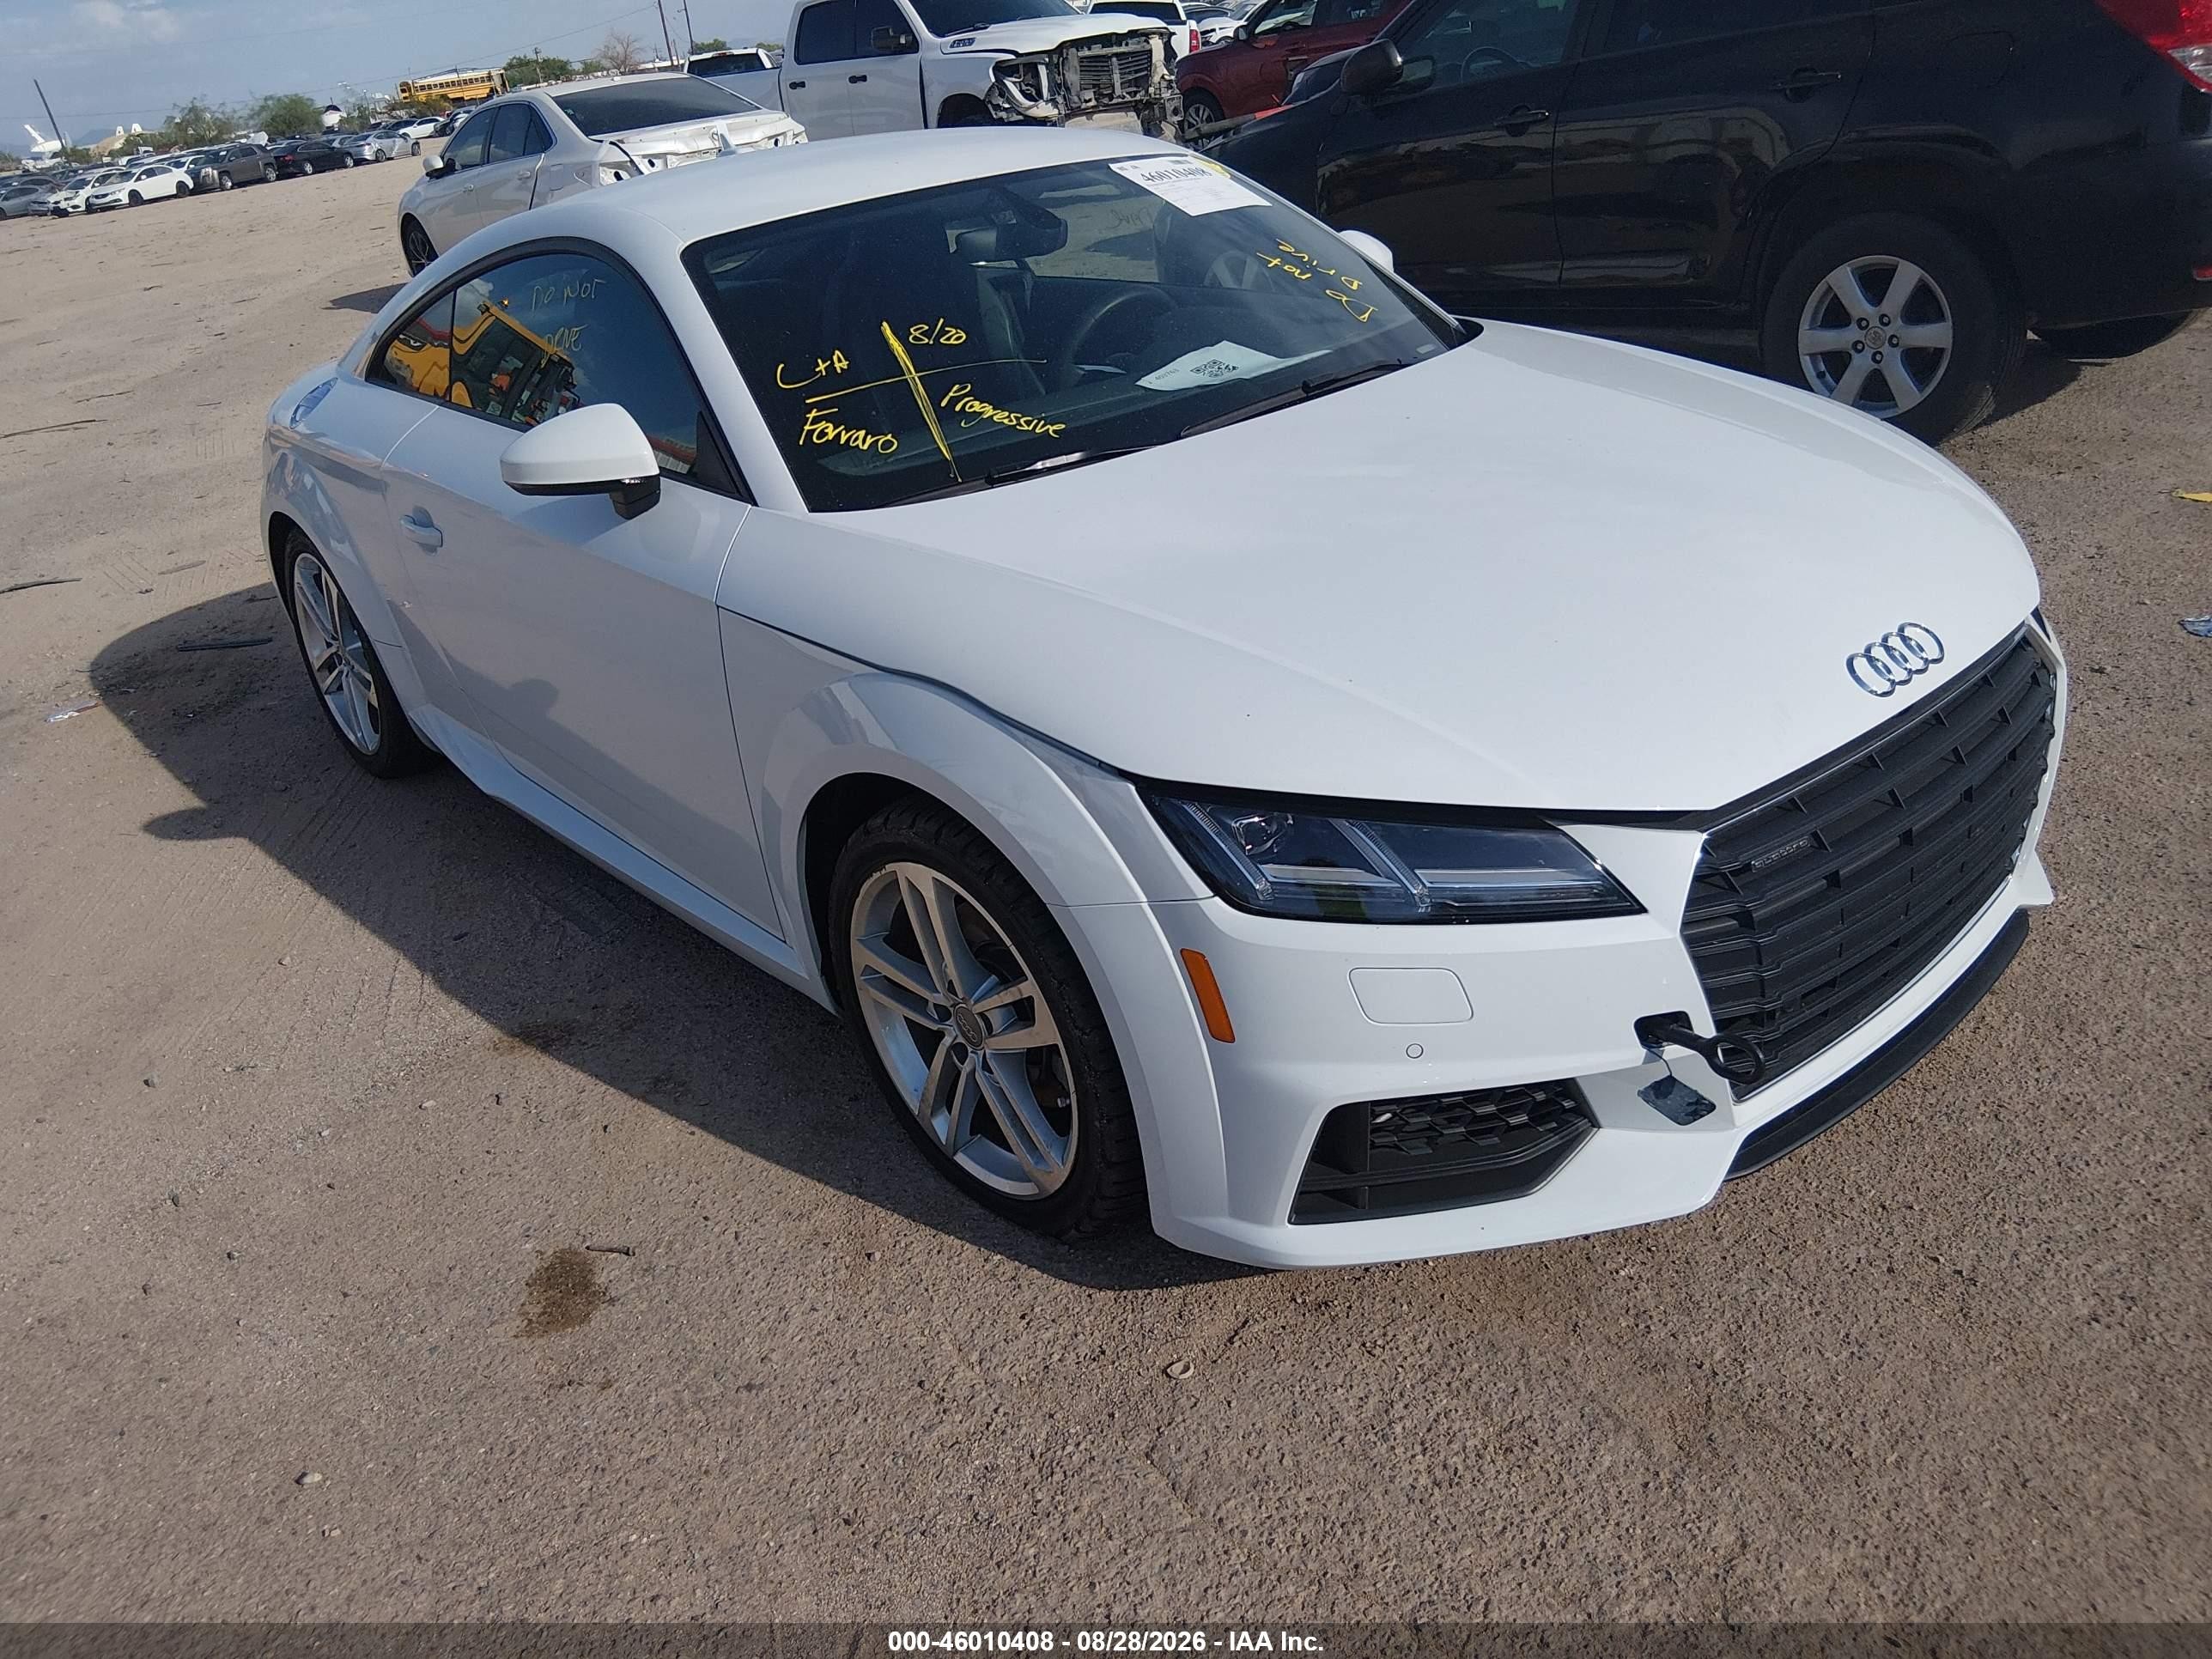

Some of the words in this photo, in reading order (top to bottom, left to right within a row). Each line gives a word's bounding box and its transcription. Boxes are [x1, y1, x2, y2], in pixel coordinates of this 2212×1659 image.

[1256, 252, 1312, 279] not
[563, 278, 606, 306] NOT
[908, 318, 967, 344] 8/20
[940, 383, 1066, 438] Progressive
[1754, 839, 1809, 868] quattro
